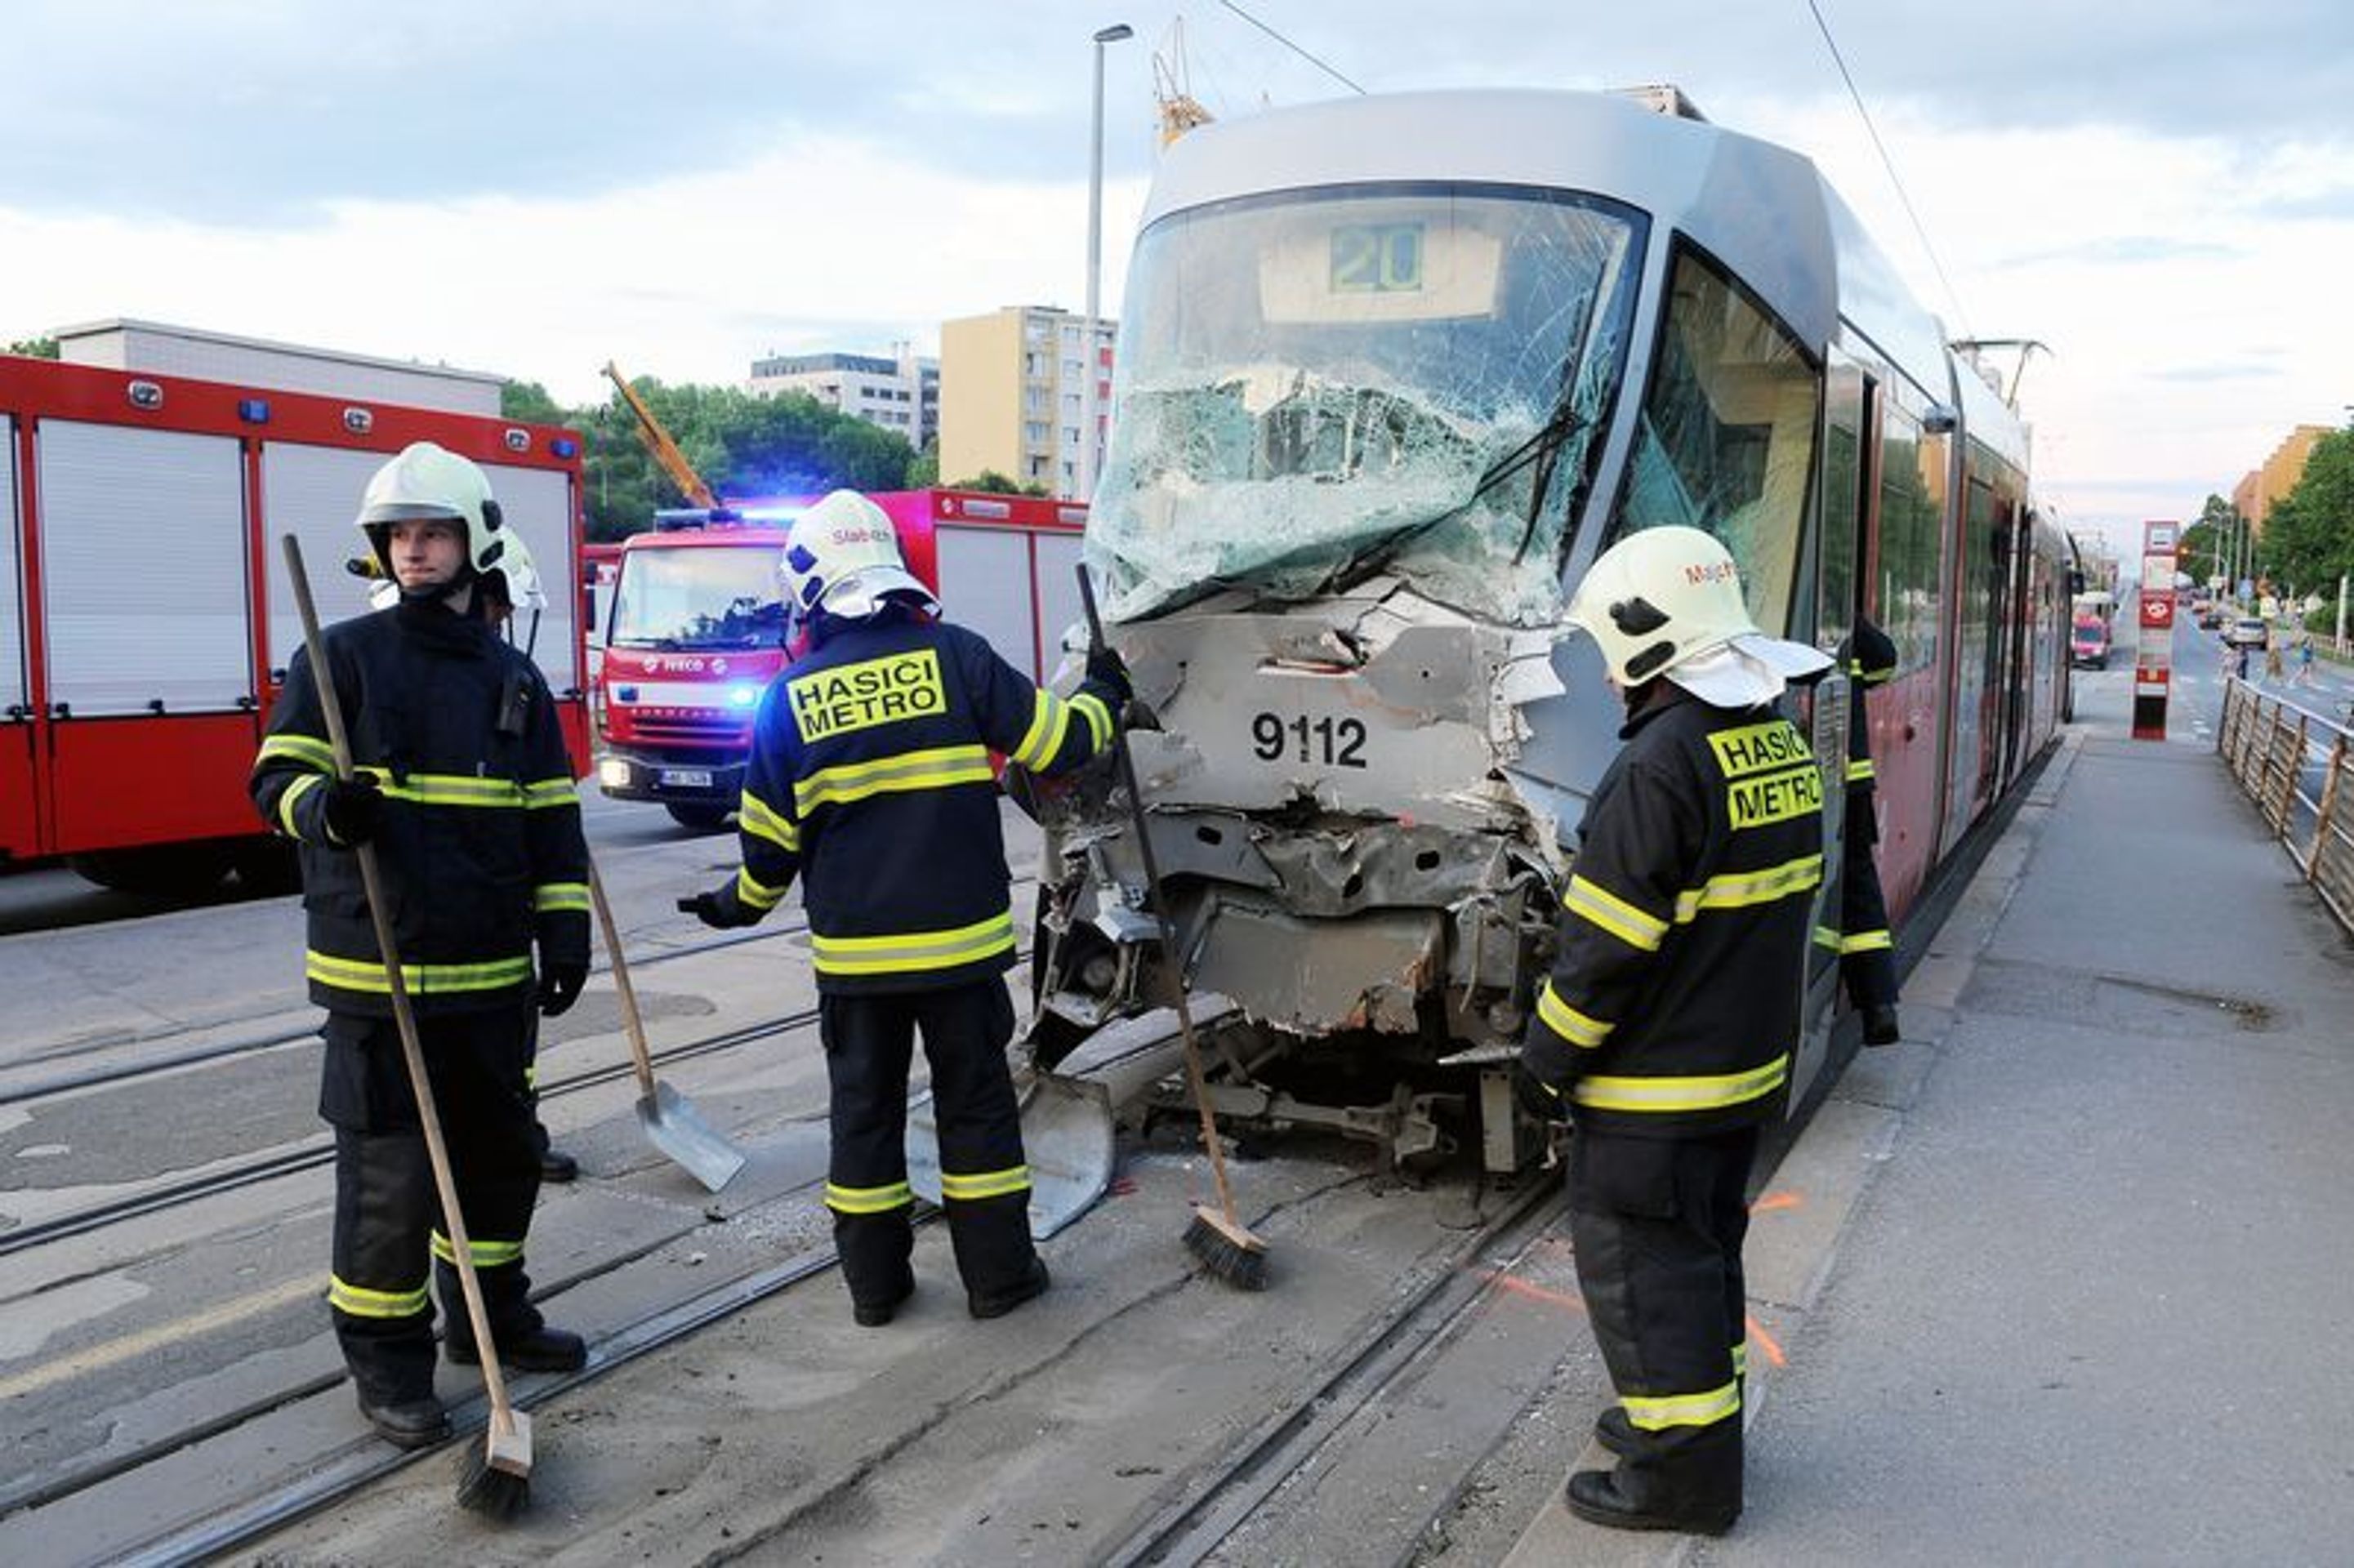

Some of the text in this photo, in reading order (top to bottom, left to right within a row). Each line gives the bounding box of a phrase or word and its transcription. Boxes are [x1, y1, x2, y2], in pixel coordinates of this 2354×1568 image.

[1332, 225, 1421, 292] 20
[664, 657, 704, 672] IVECO
[803, 685, 937, 736] METRO
[1252, 711, 1367, 768] 9112
